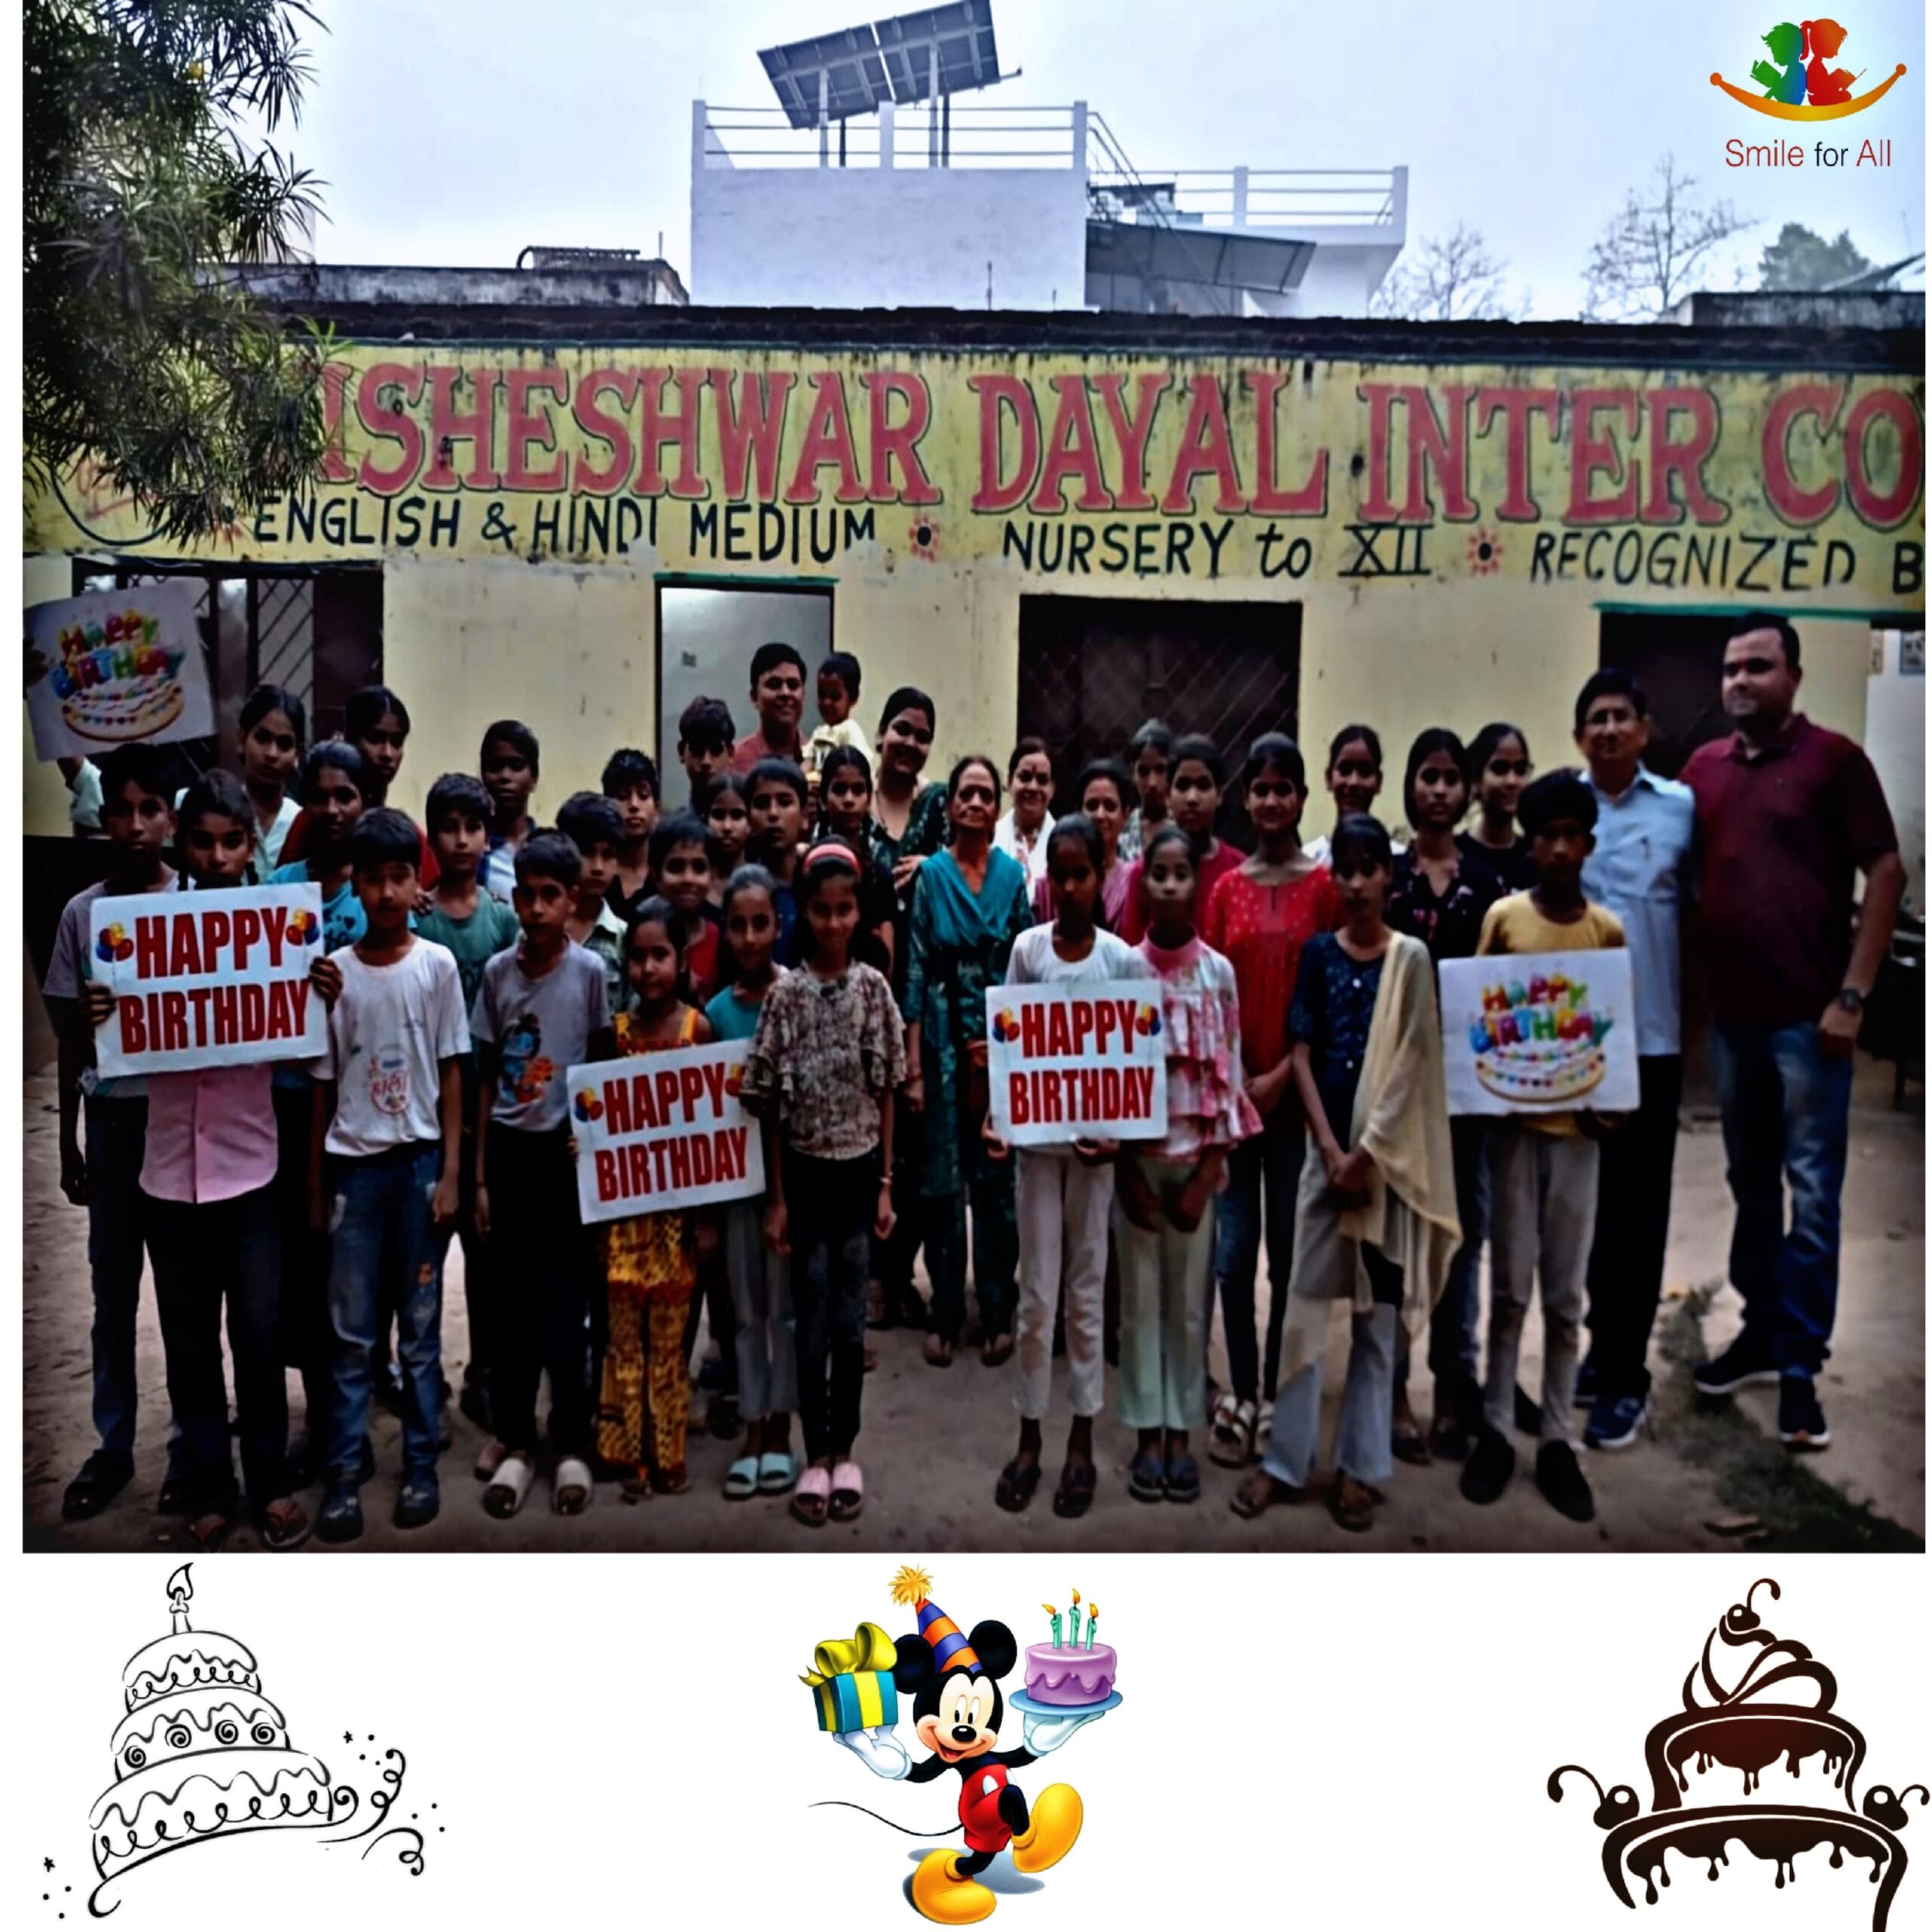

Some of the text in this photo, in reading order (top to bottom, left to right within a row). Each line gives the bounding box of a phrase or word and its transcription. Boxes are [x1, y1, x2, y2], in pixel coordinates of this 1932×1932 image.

[264, 361, 943, 507] ISHESHWAR
[968, 370, 1329, 518] DAYAL
[1358, 381, 1732, 527] INTER
[1760, 383, 1925, 534] CO
[254, 494, 460, 546] ENGLISH
[481, 506, 517, 549] &
[531, 497, 658, 555] HINDI
[689, 501, 875, 565] MEDIUM
[1001, 518, 1235, 575] NURSERY
[1255, 522, 1312, 580] to
[1338, 524, 1435, 578] XII
[1530, 527, 1858, 592] RECOGNIZED
[134, 906, 288, 980] HAPPY
[118, 978, 309, 1054] BIRTHDAY
[1021, 999, 1137, 1058] HAPPY
[603, 1061, 726, 1135] HAPPY
[1009, 1066, 1155, 1125] BIRTHDAY
[594, 1126, 749, 1201] BIRTHDAY
